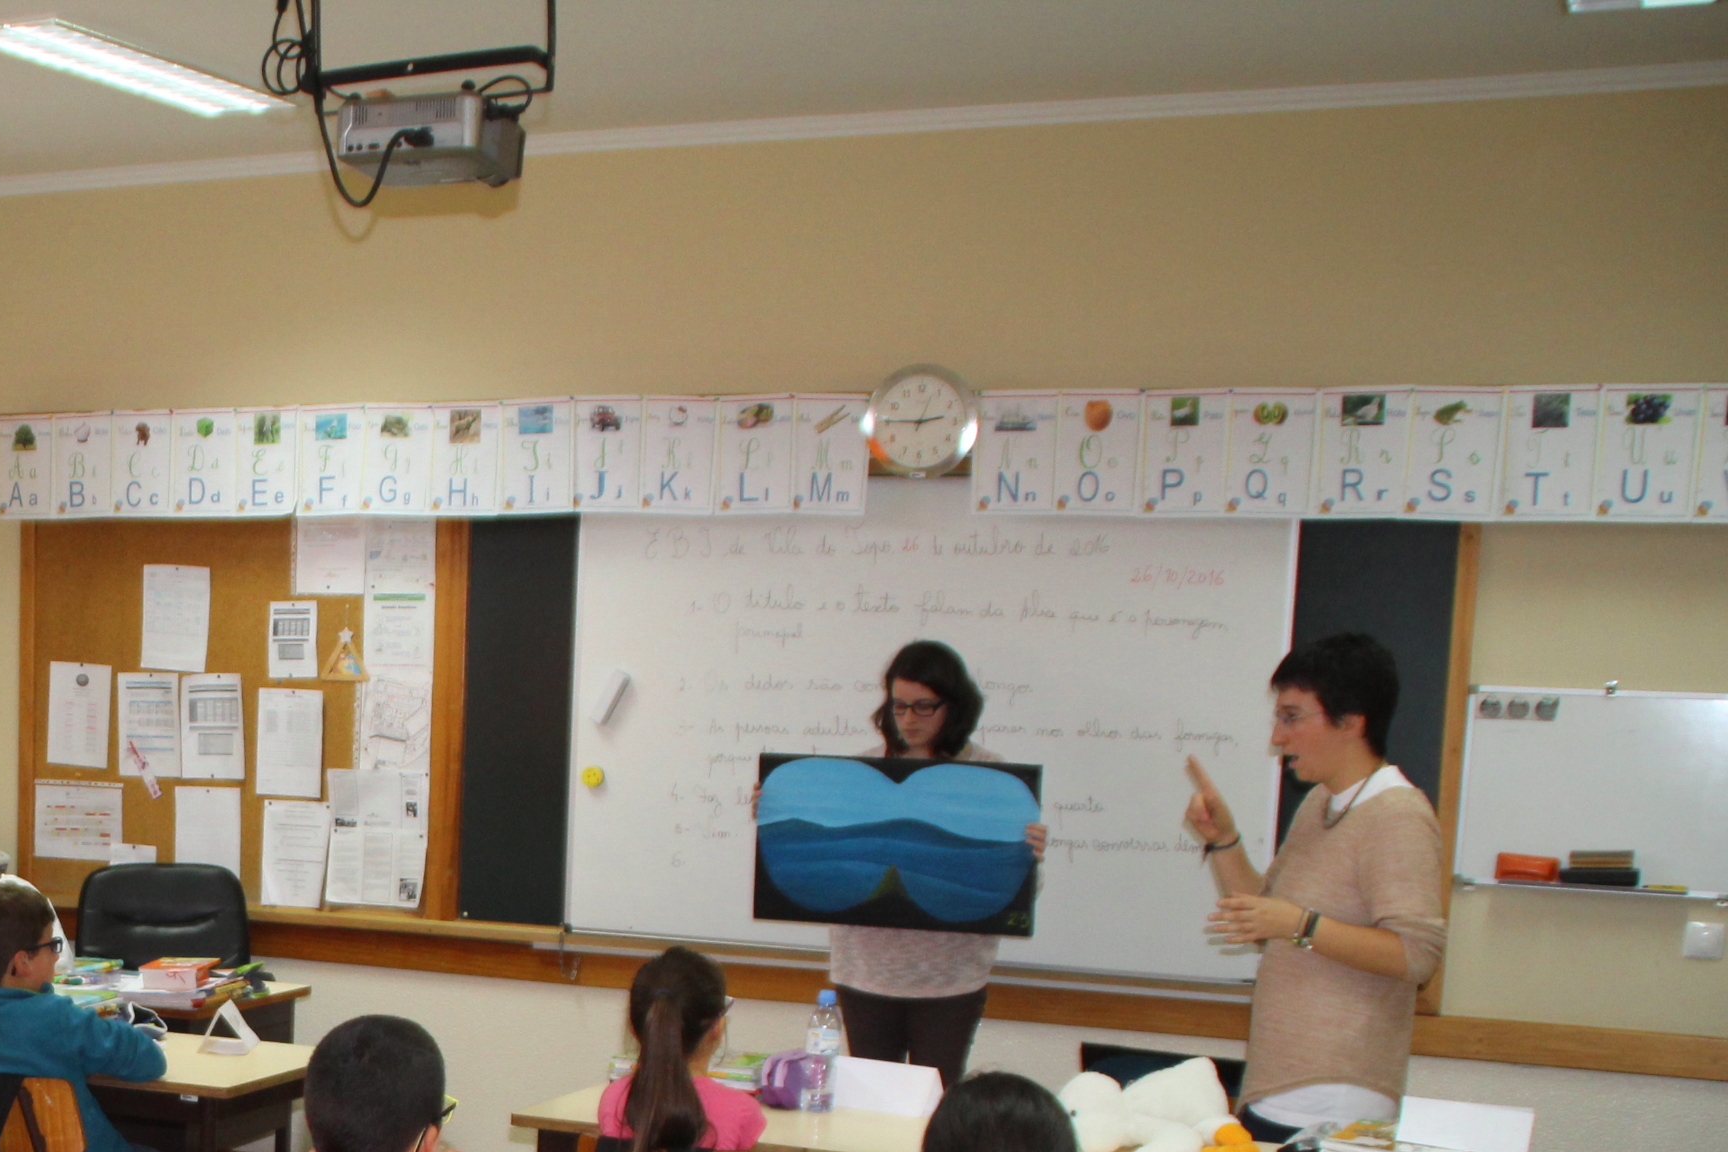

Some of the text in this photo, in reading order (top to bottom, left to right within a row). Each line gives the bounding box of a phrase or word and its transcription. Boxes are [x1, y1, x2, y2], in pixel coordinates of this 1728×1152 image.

[9, 481, 38, 508] A a
[69, 480, 86, 508] B
[126, 480, 160, 508] C c
[188, 476, 221, 505] D d
[251, 478, 285, 506] E e
[318, 475, 336, 504] F
[378, 474, 411, 506] G g
[448, 476, 479, 507] H h
[527, 474, 536, 504] I
[589, 470, 610, 500] J
[659, 470, 692, 502] K k
[739, 471, 760, 502] L
[809, 470, 850, 502] M m
[997, 470, 1037, 504] N n
[1077, 470, 1116, 503] O o
[1160, 468, 1203, 507] P p
[1244, 468, 1288, 508] Q q
[1340, 468, 1390, 502] R r
[1427, 467, 1476, 503] S s
[1524, 471, 1551, 506] T
[1622, 468, 1674, 504] U u
[1130, 564, 1224, 591] 26/10/2016
[853, 583, 901, 613] texto
